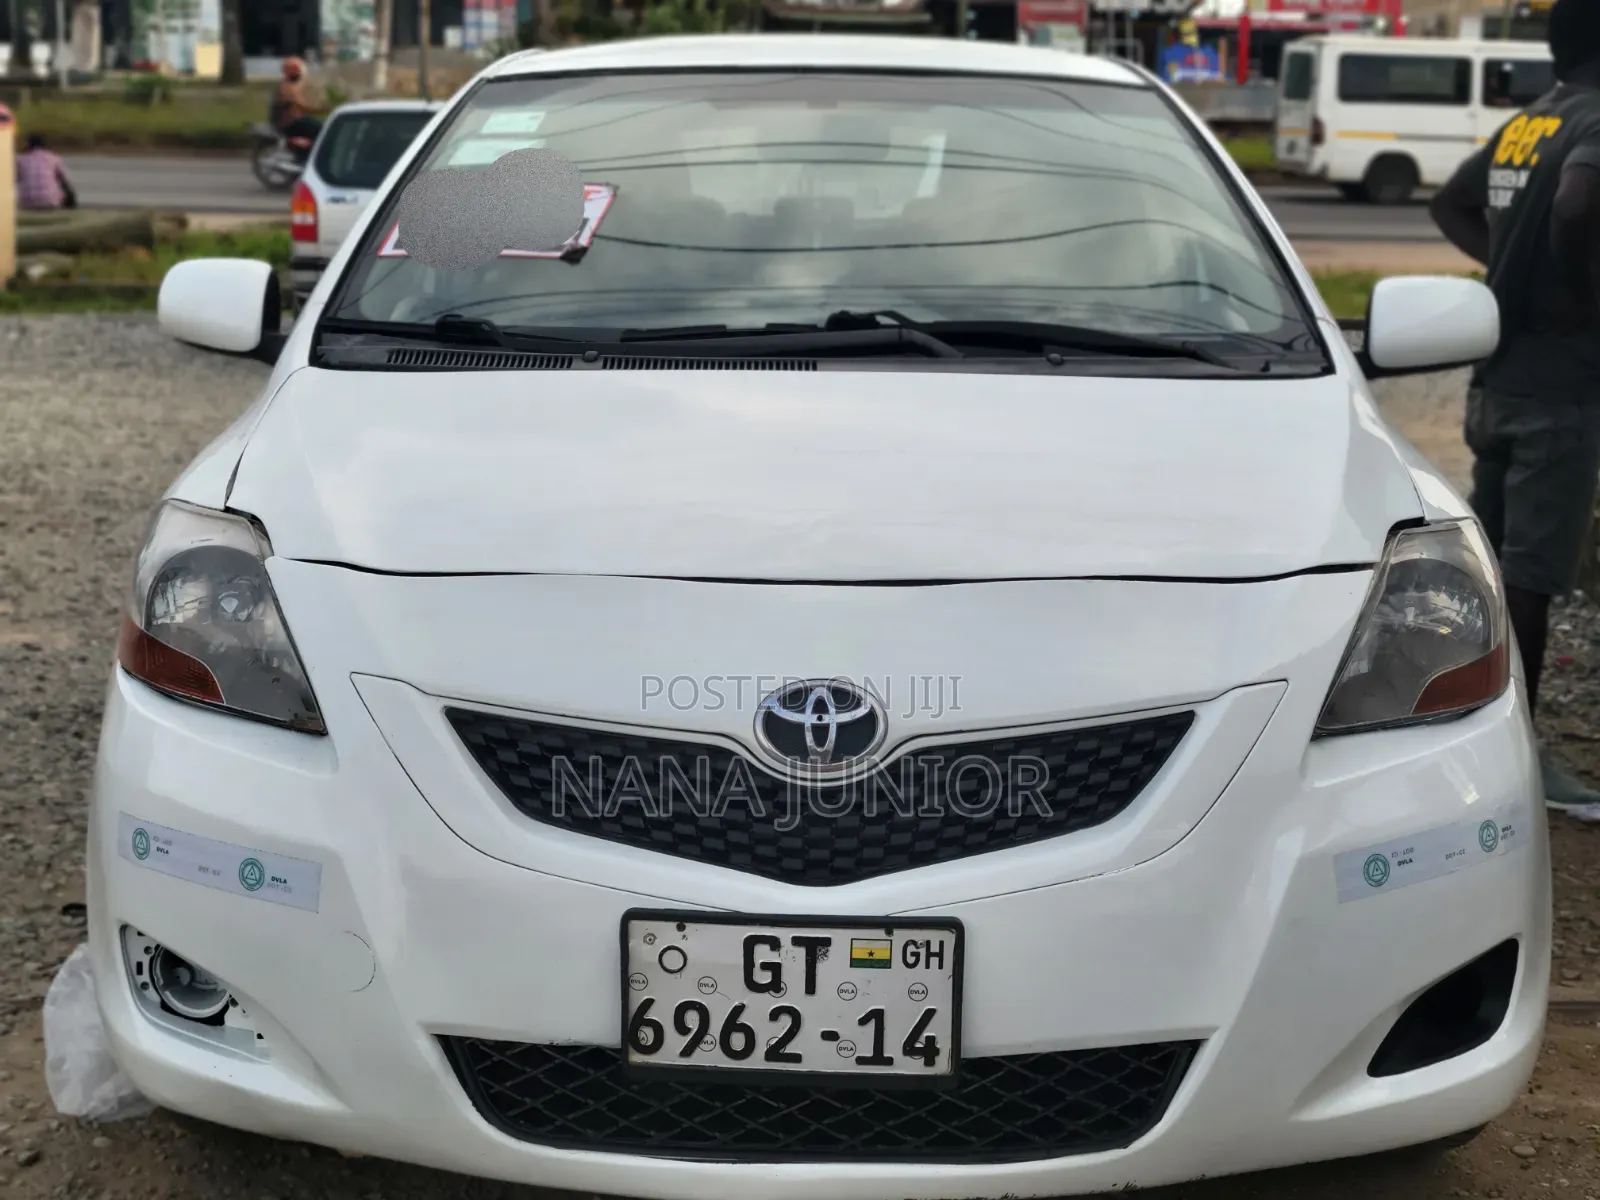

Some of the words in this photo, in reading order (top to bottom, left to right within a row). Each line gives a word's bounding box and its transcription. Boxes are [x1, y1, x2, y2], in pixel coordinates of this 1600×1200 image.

[1397, 858, 1414, 867] DVLA
[271, 876, 288, 885] DVLA
[743, 934, 832, 995] GT
[902, 939, 945, 970] GH
[628, 997, 940, 1068] 6962-14
